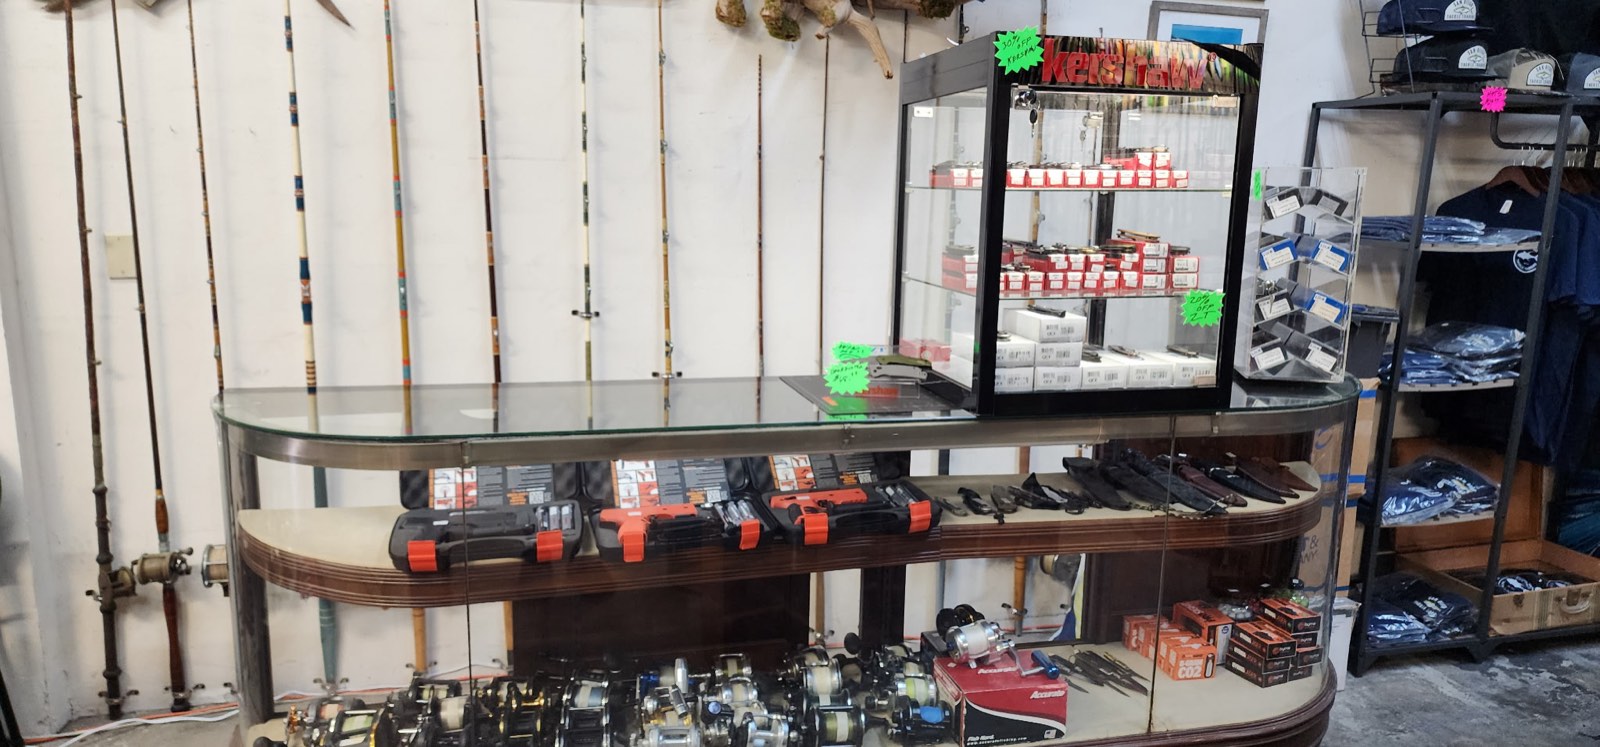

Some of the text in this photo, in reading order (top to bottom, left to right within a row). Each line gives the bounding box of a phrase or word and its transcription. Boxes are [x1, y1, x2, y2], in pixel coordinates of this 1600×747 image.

[1190, 293, 1210, 305] 20%
[1196, 304, 1215, 312] OFF
[1178, 667, 1202, 679] CO2
[1030, 690, 1065, 699] Accurate
